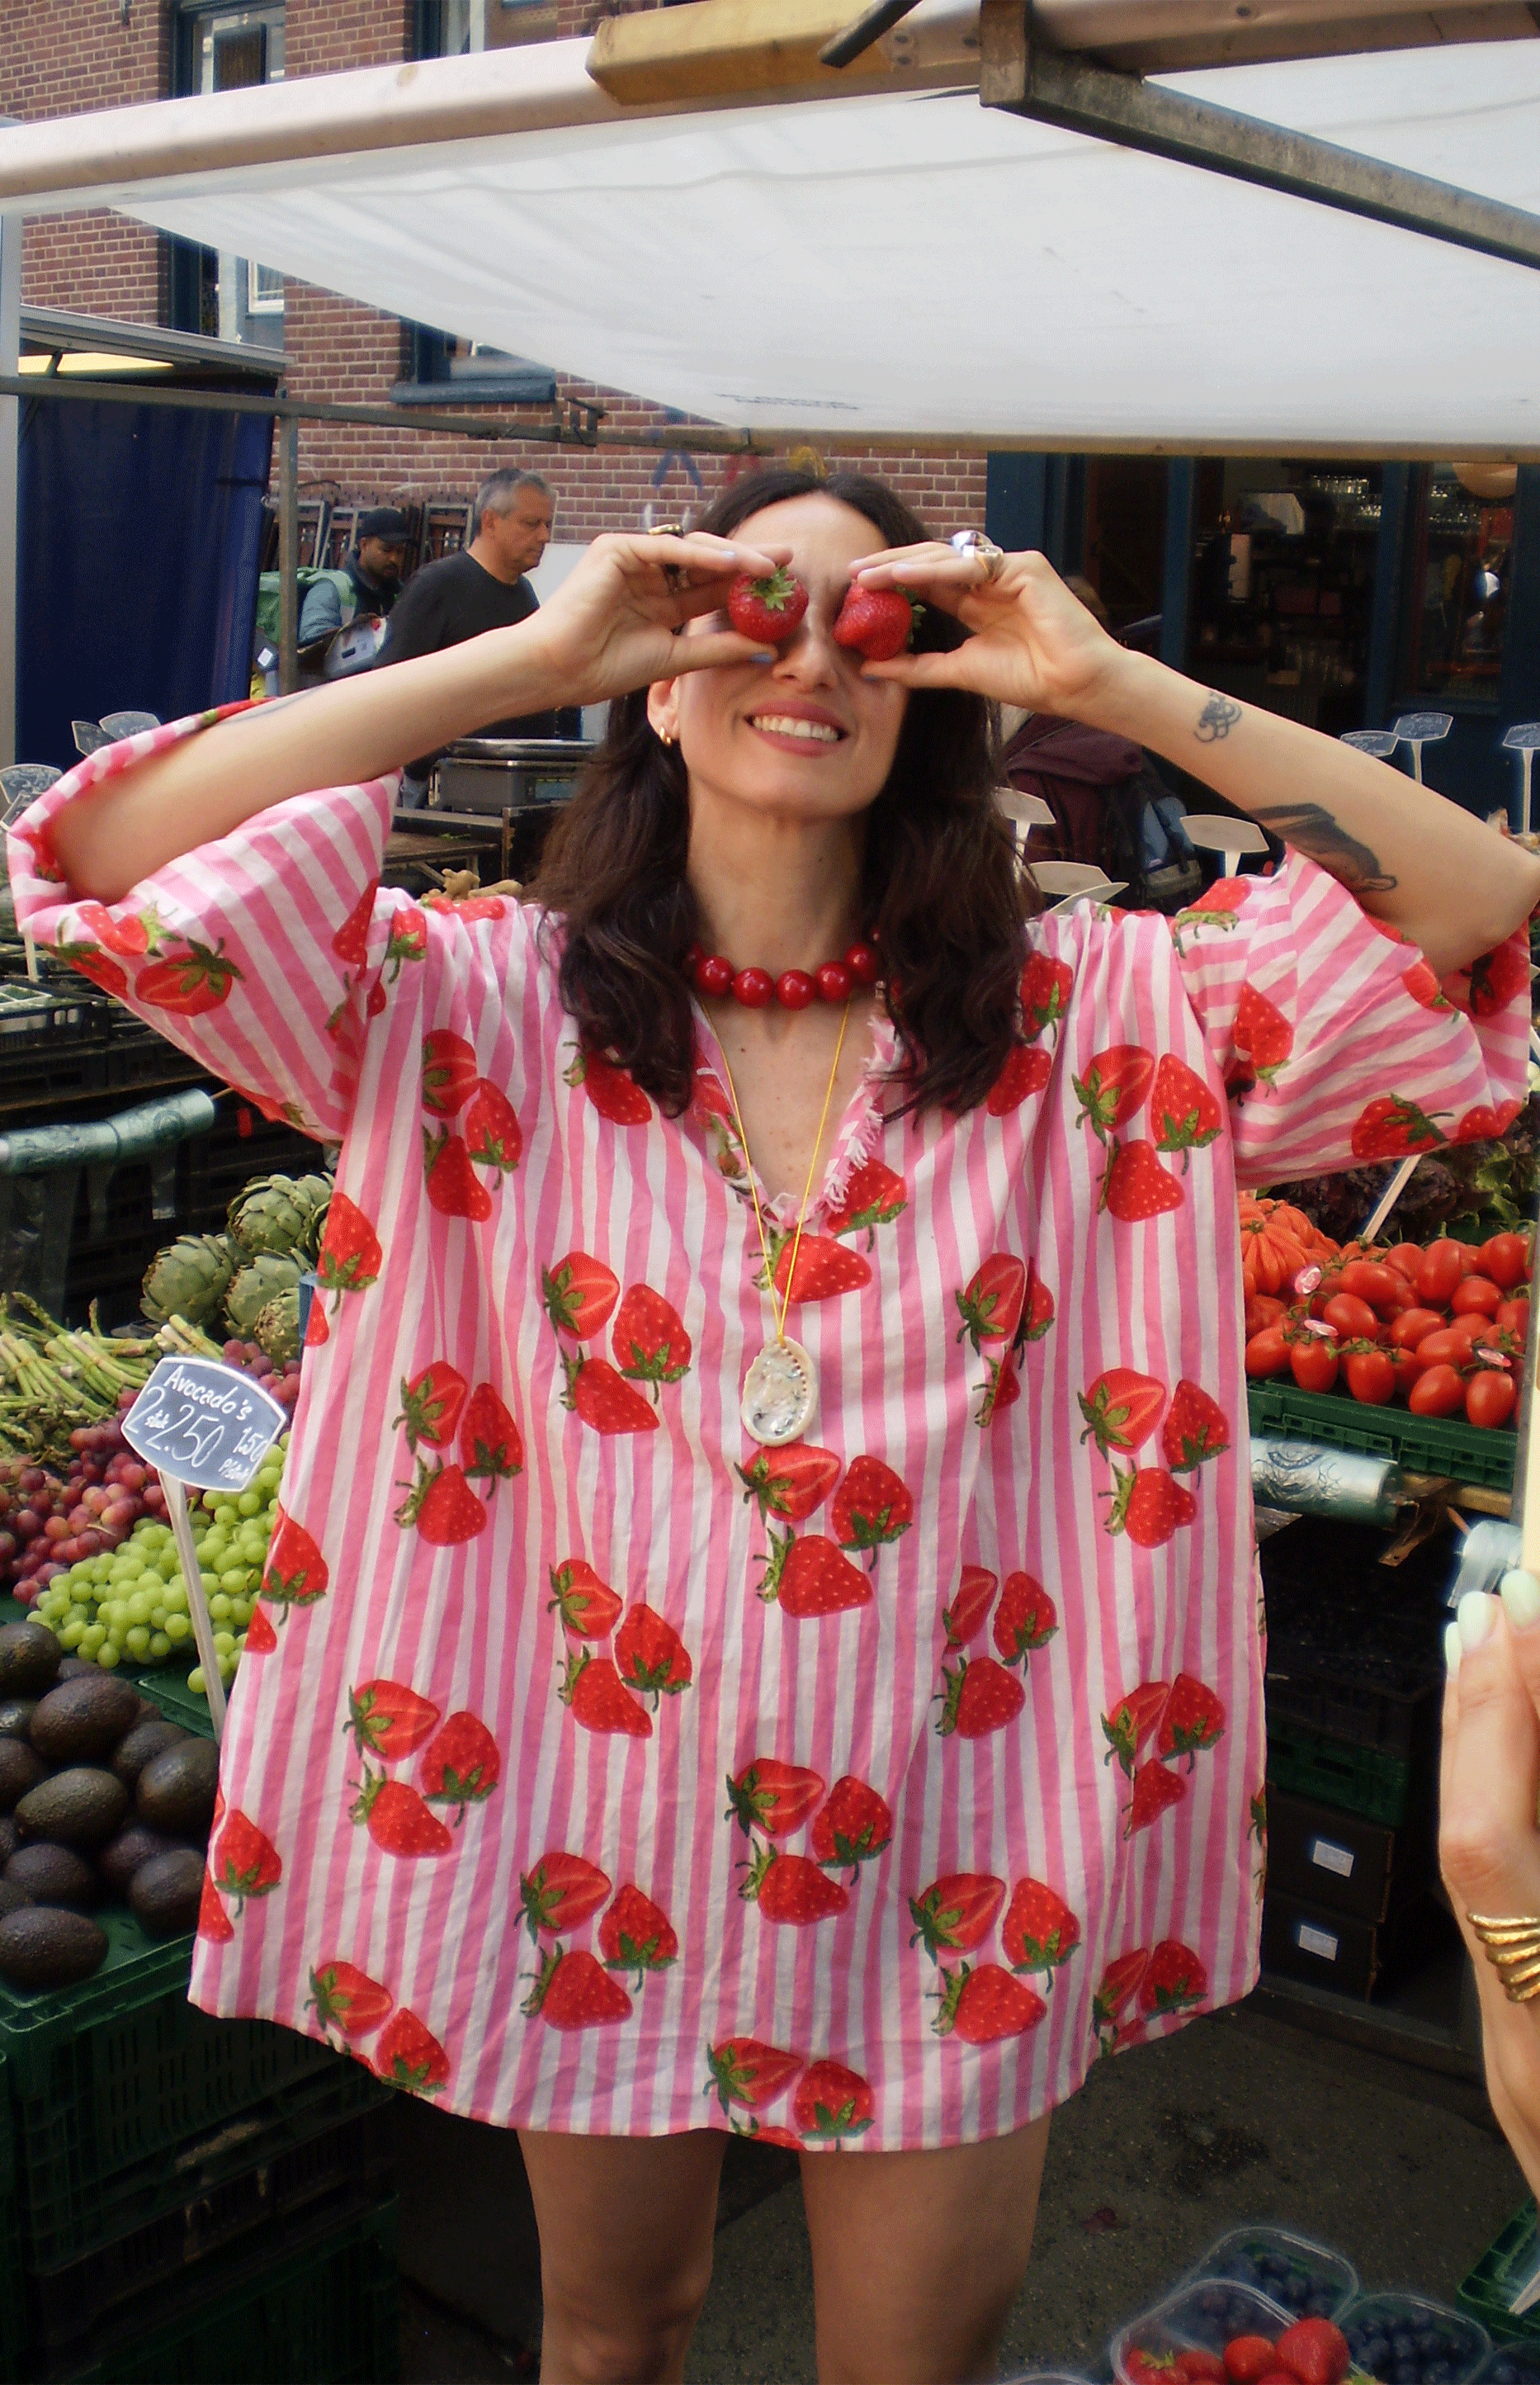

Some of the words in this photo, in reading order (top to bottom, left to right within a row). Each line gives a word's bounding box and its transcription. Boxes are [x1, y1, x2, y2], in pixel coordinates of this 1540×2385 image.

[125, 1385, 165, 1434] 2
[145, 1404, 224, 1467] 2.50
[163, 1365, 253, 1421] Avocado's
